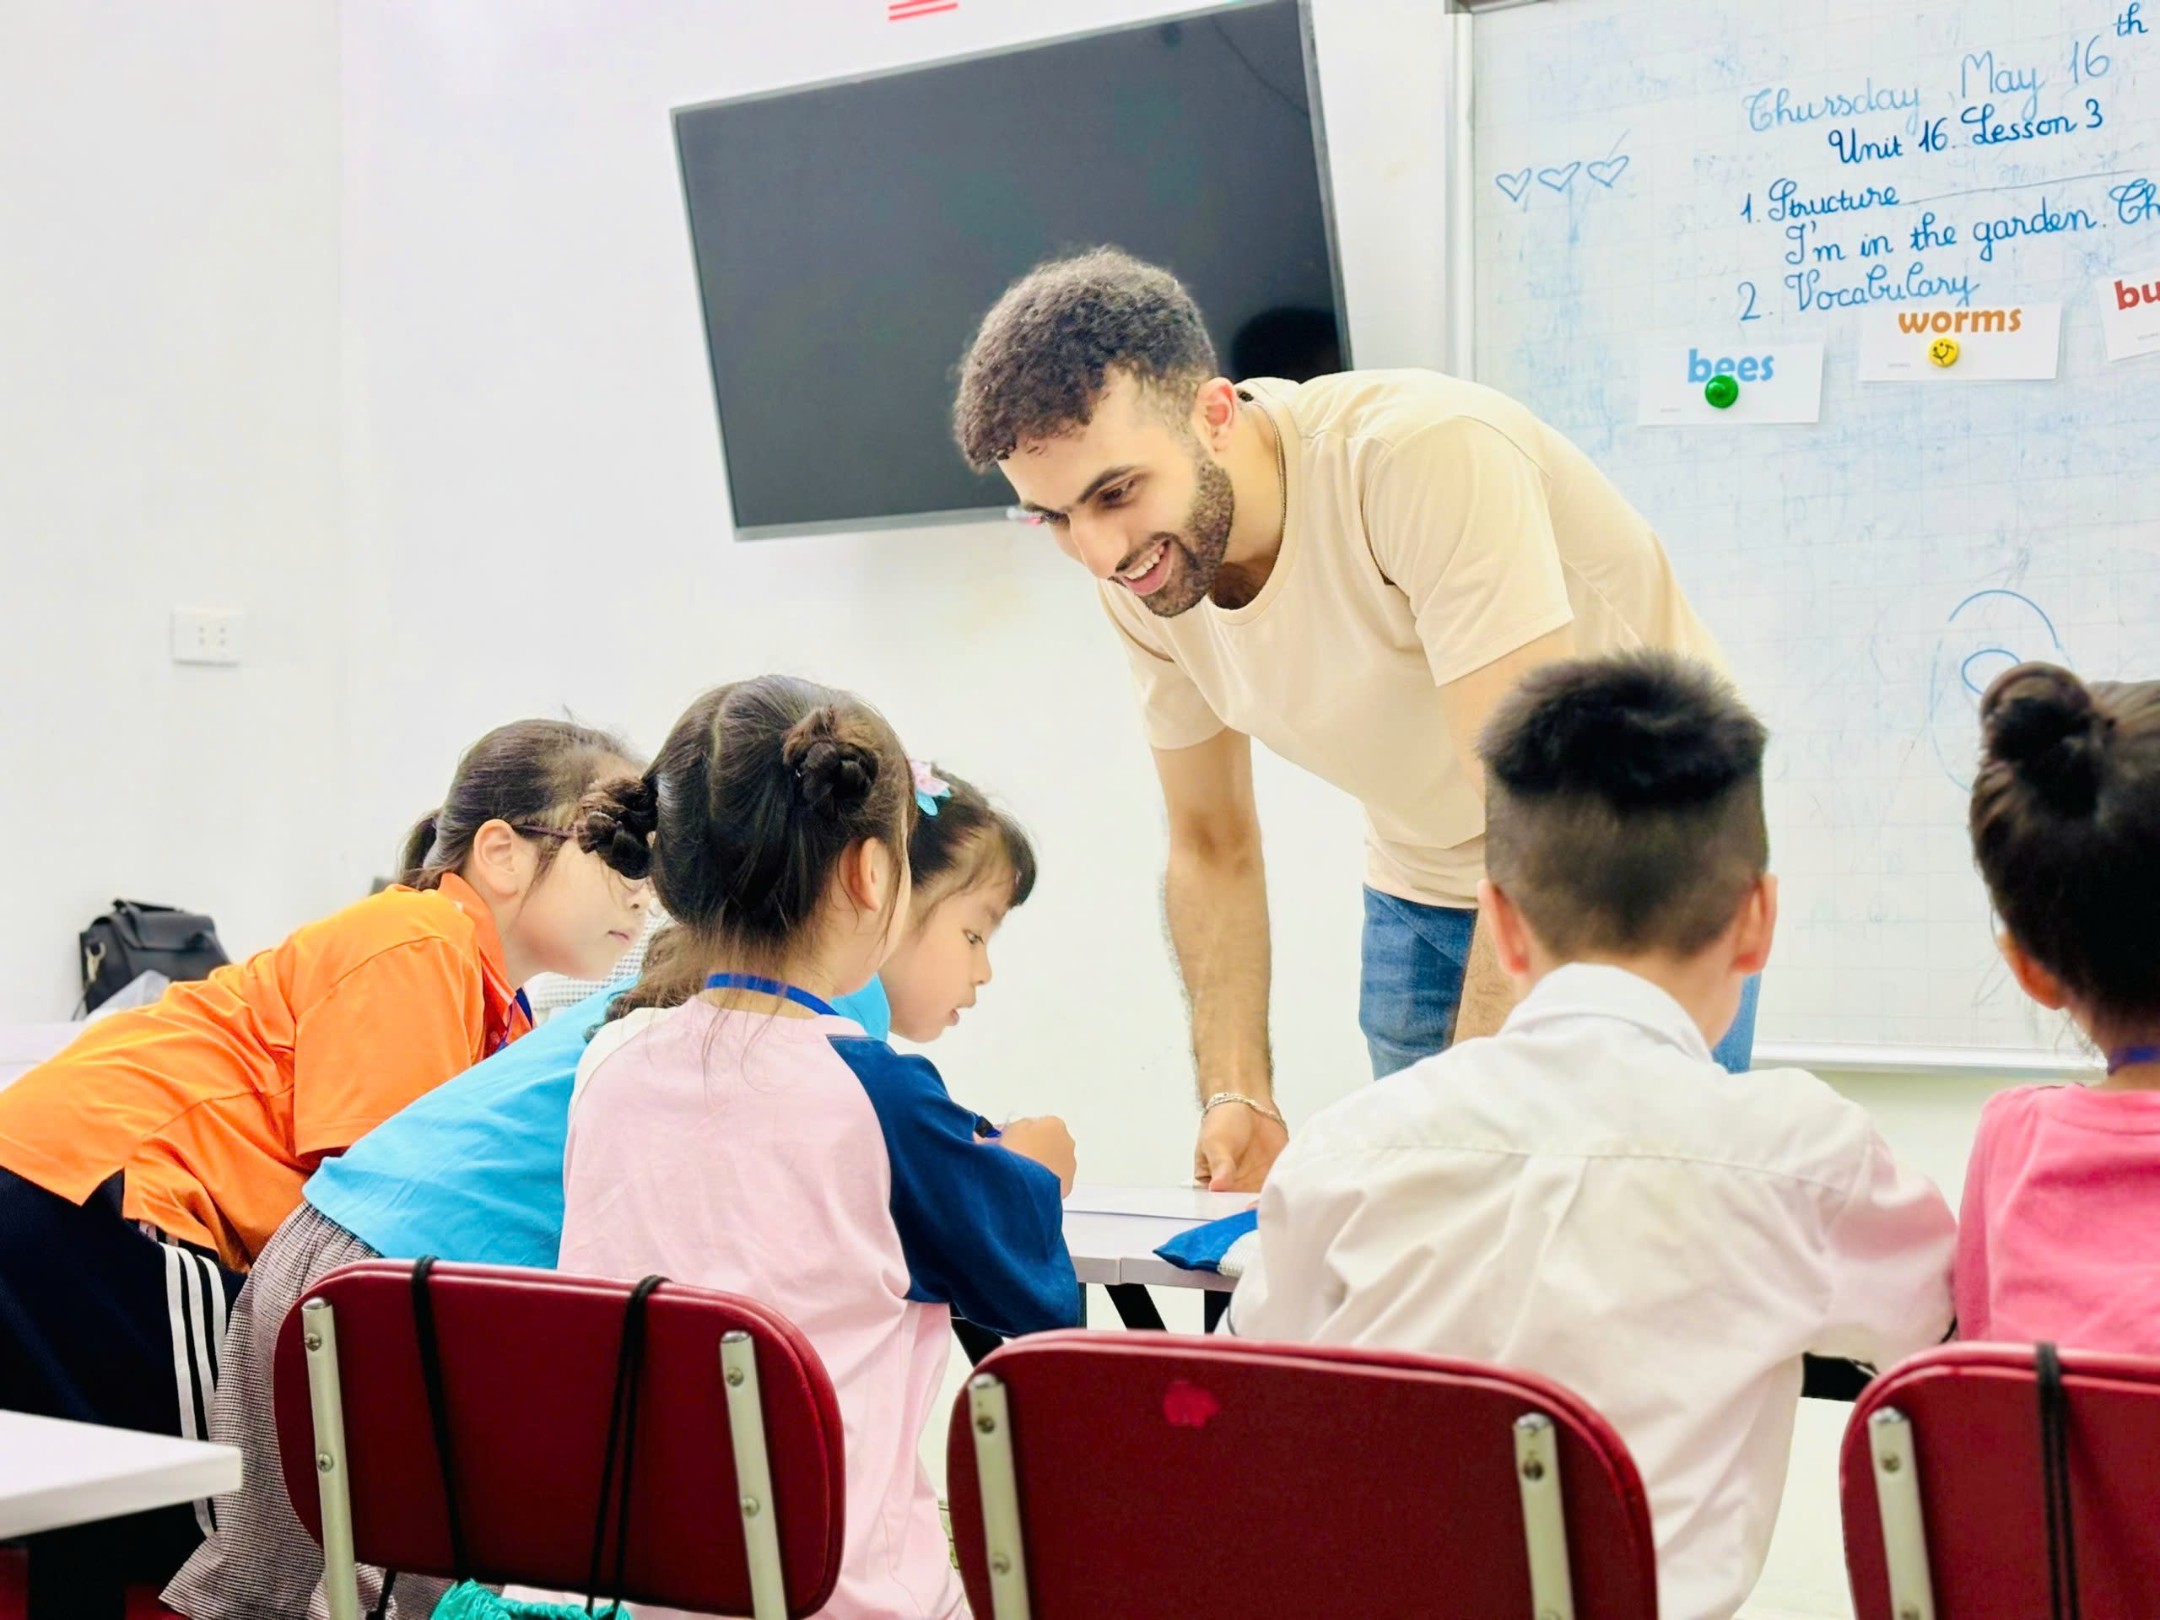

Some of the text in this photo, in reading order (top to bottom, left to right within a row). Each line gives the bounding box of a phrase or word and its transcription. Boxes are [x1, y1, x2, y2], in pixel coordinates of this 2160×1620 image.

[1961, 50, 2045, 120] May
[1828, 127, 1903, 164] Unit
[1961, 103, 2077, 145] Lesson
[2086, 99, 2104, 129] 3
[1768, 177, 1900, 221] Structure
[1785, 220, 1847, 265] I'm
[1860, 233, 1894, 259] in
[1910, 211, 1958, 251] the
[1785, 261, 1981, 307] Vocabulary
[1898, 308, 2022, 334] worms
[1687, 347, 1775, 383] bees
